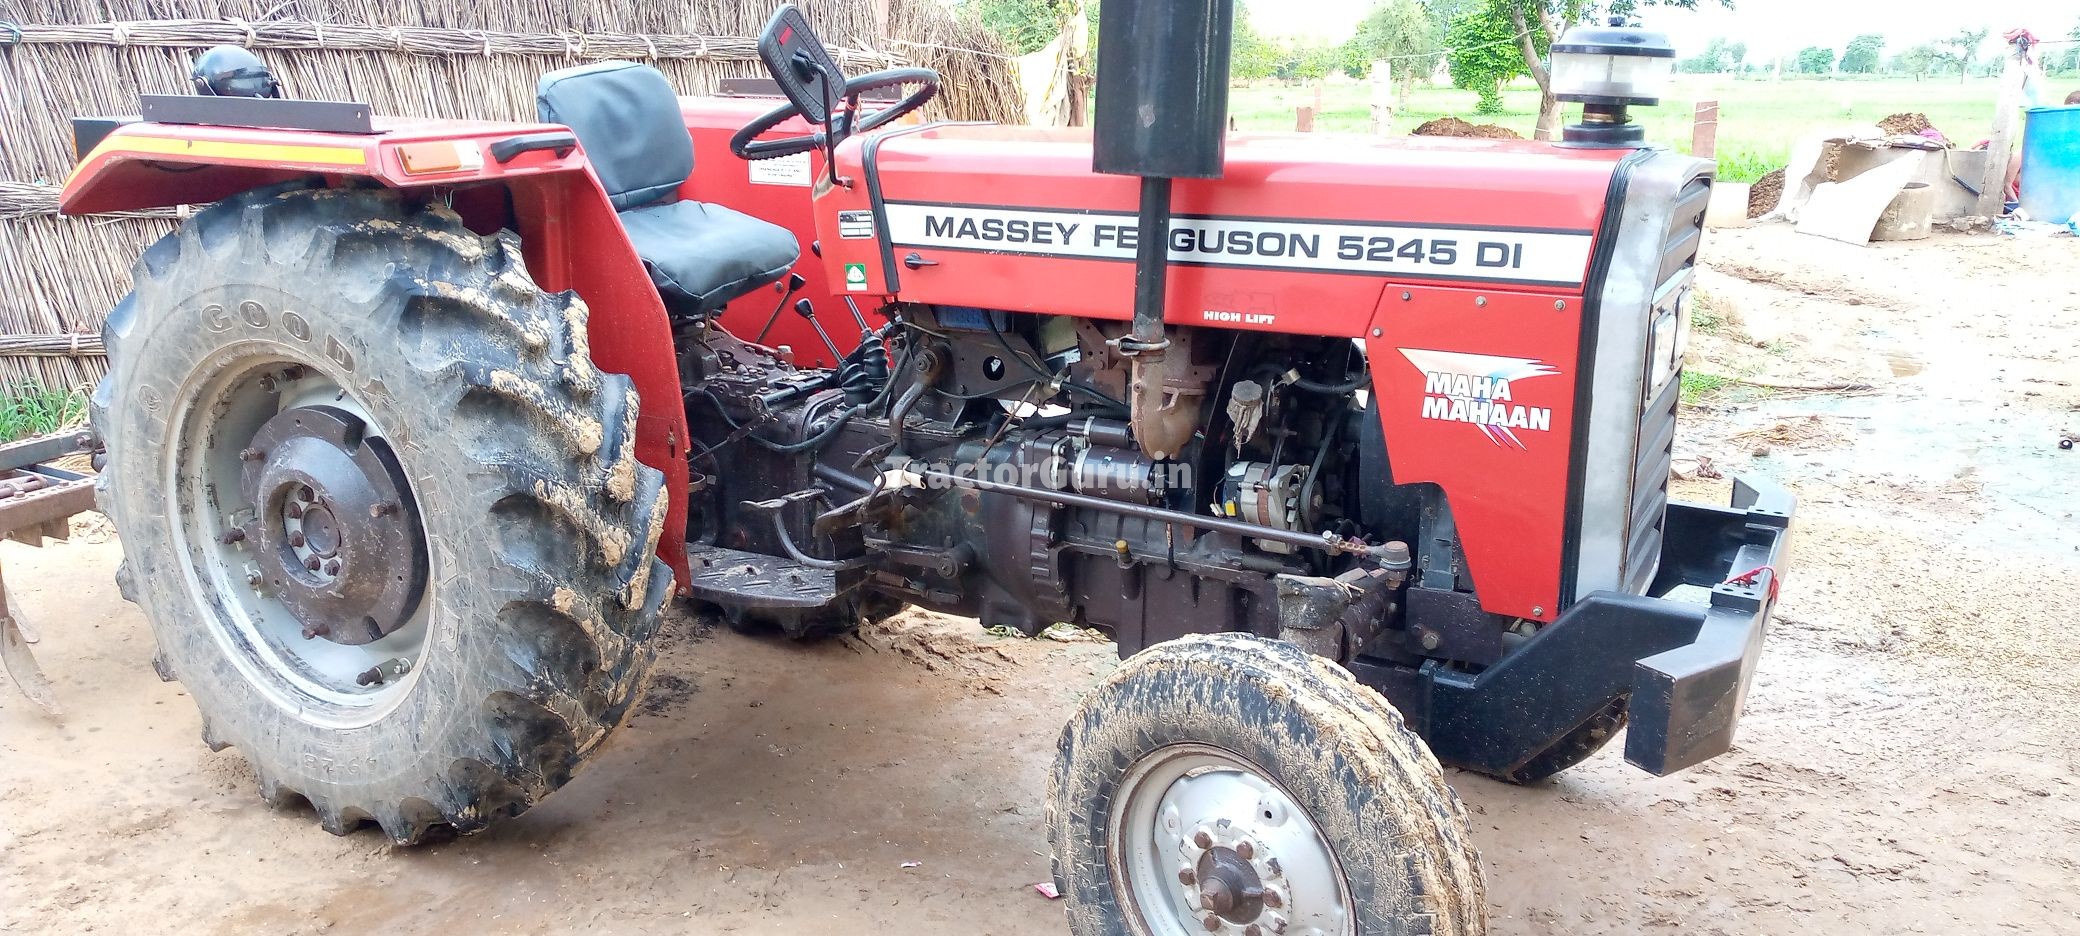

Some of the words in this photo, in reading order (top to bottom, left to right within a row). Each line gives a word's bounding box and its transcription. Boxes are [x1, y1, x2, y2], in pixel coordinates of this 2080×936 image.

[925, 216, 1080, 245] MASSEY
[1094, 224, 1320, 258] FEGUSON
[1337, 236, 1457, 265] 5245
[1475, 241, 1523, 269] DI
[1203, 310, 1241, 323] HIGH
[1245, 313, 1276, 325] LIFT
[1424, 371, 1513, 401] MAHA
[1421, 396, 1551, 431] MAHAAN
